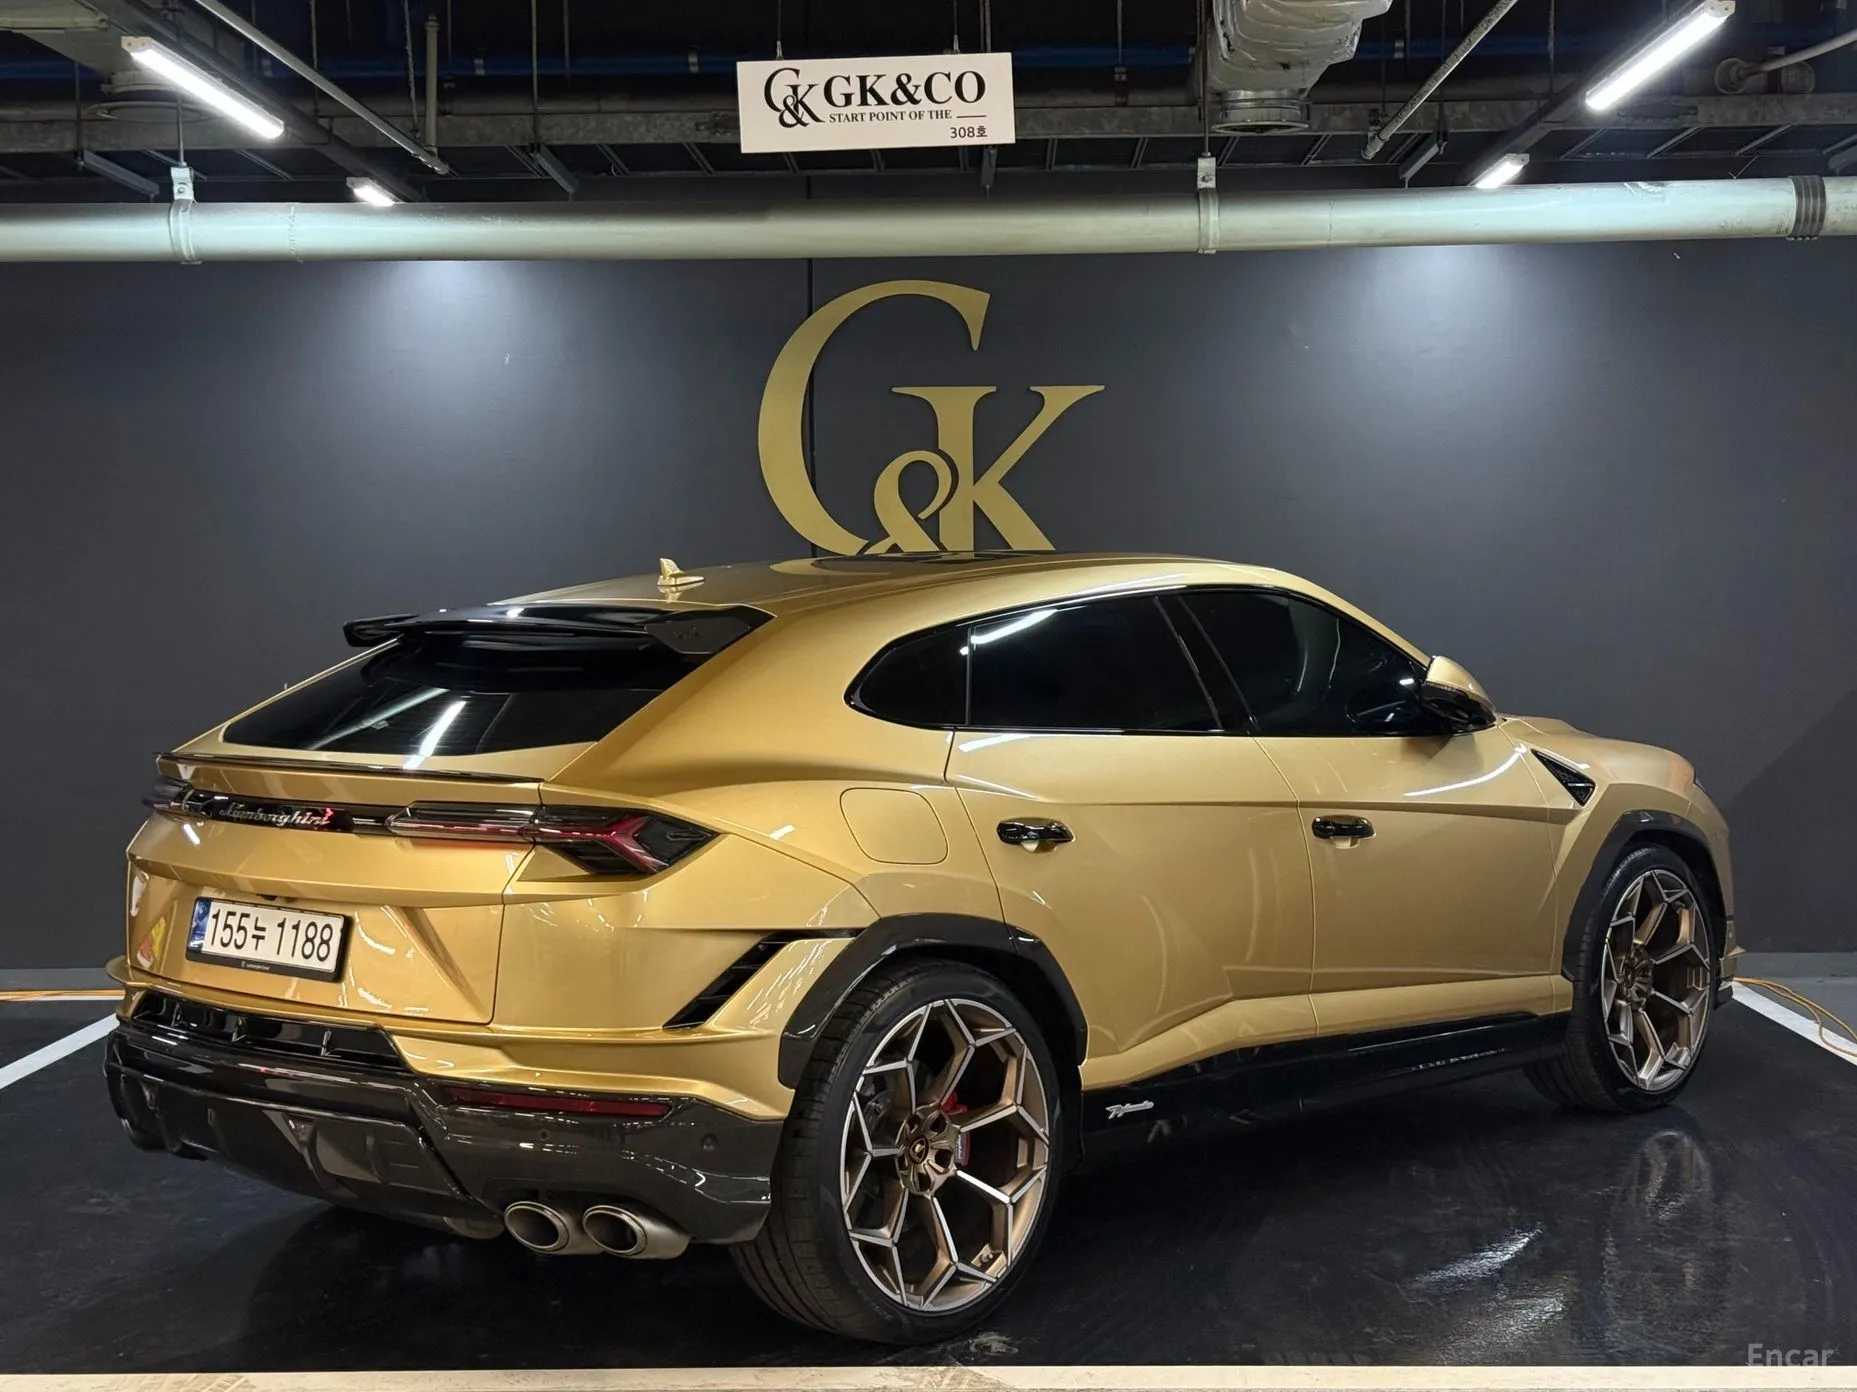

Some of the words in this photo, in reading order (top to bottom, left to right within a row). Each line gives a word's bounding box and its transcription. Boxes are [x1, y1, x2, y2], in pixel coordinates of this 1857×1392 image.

[823, 70, 986, 108] GK&CO
[829, 112, 867, 124] START
[869, 111, 906, 122] POINT
[908, 110, 925, 121] OF
[927, 109, 952, 120] THE
[949, 126, 988, 139] 308호
[211, 908, 267, 951] 155누
[277, 917, 333, 962] 1188
